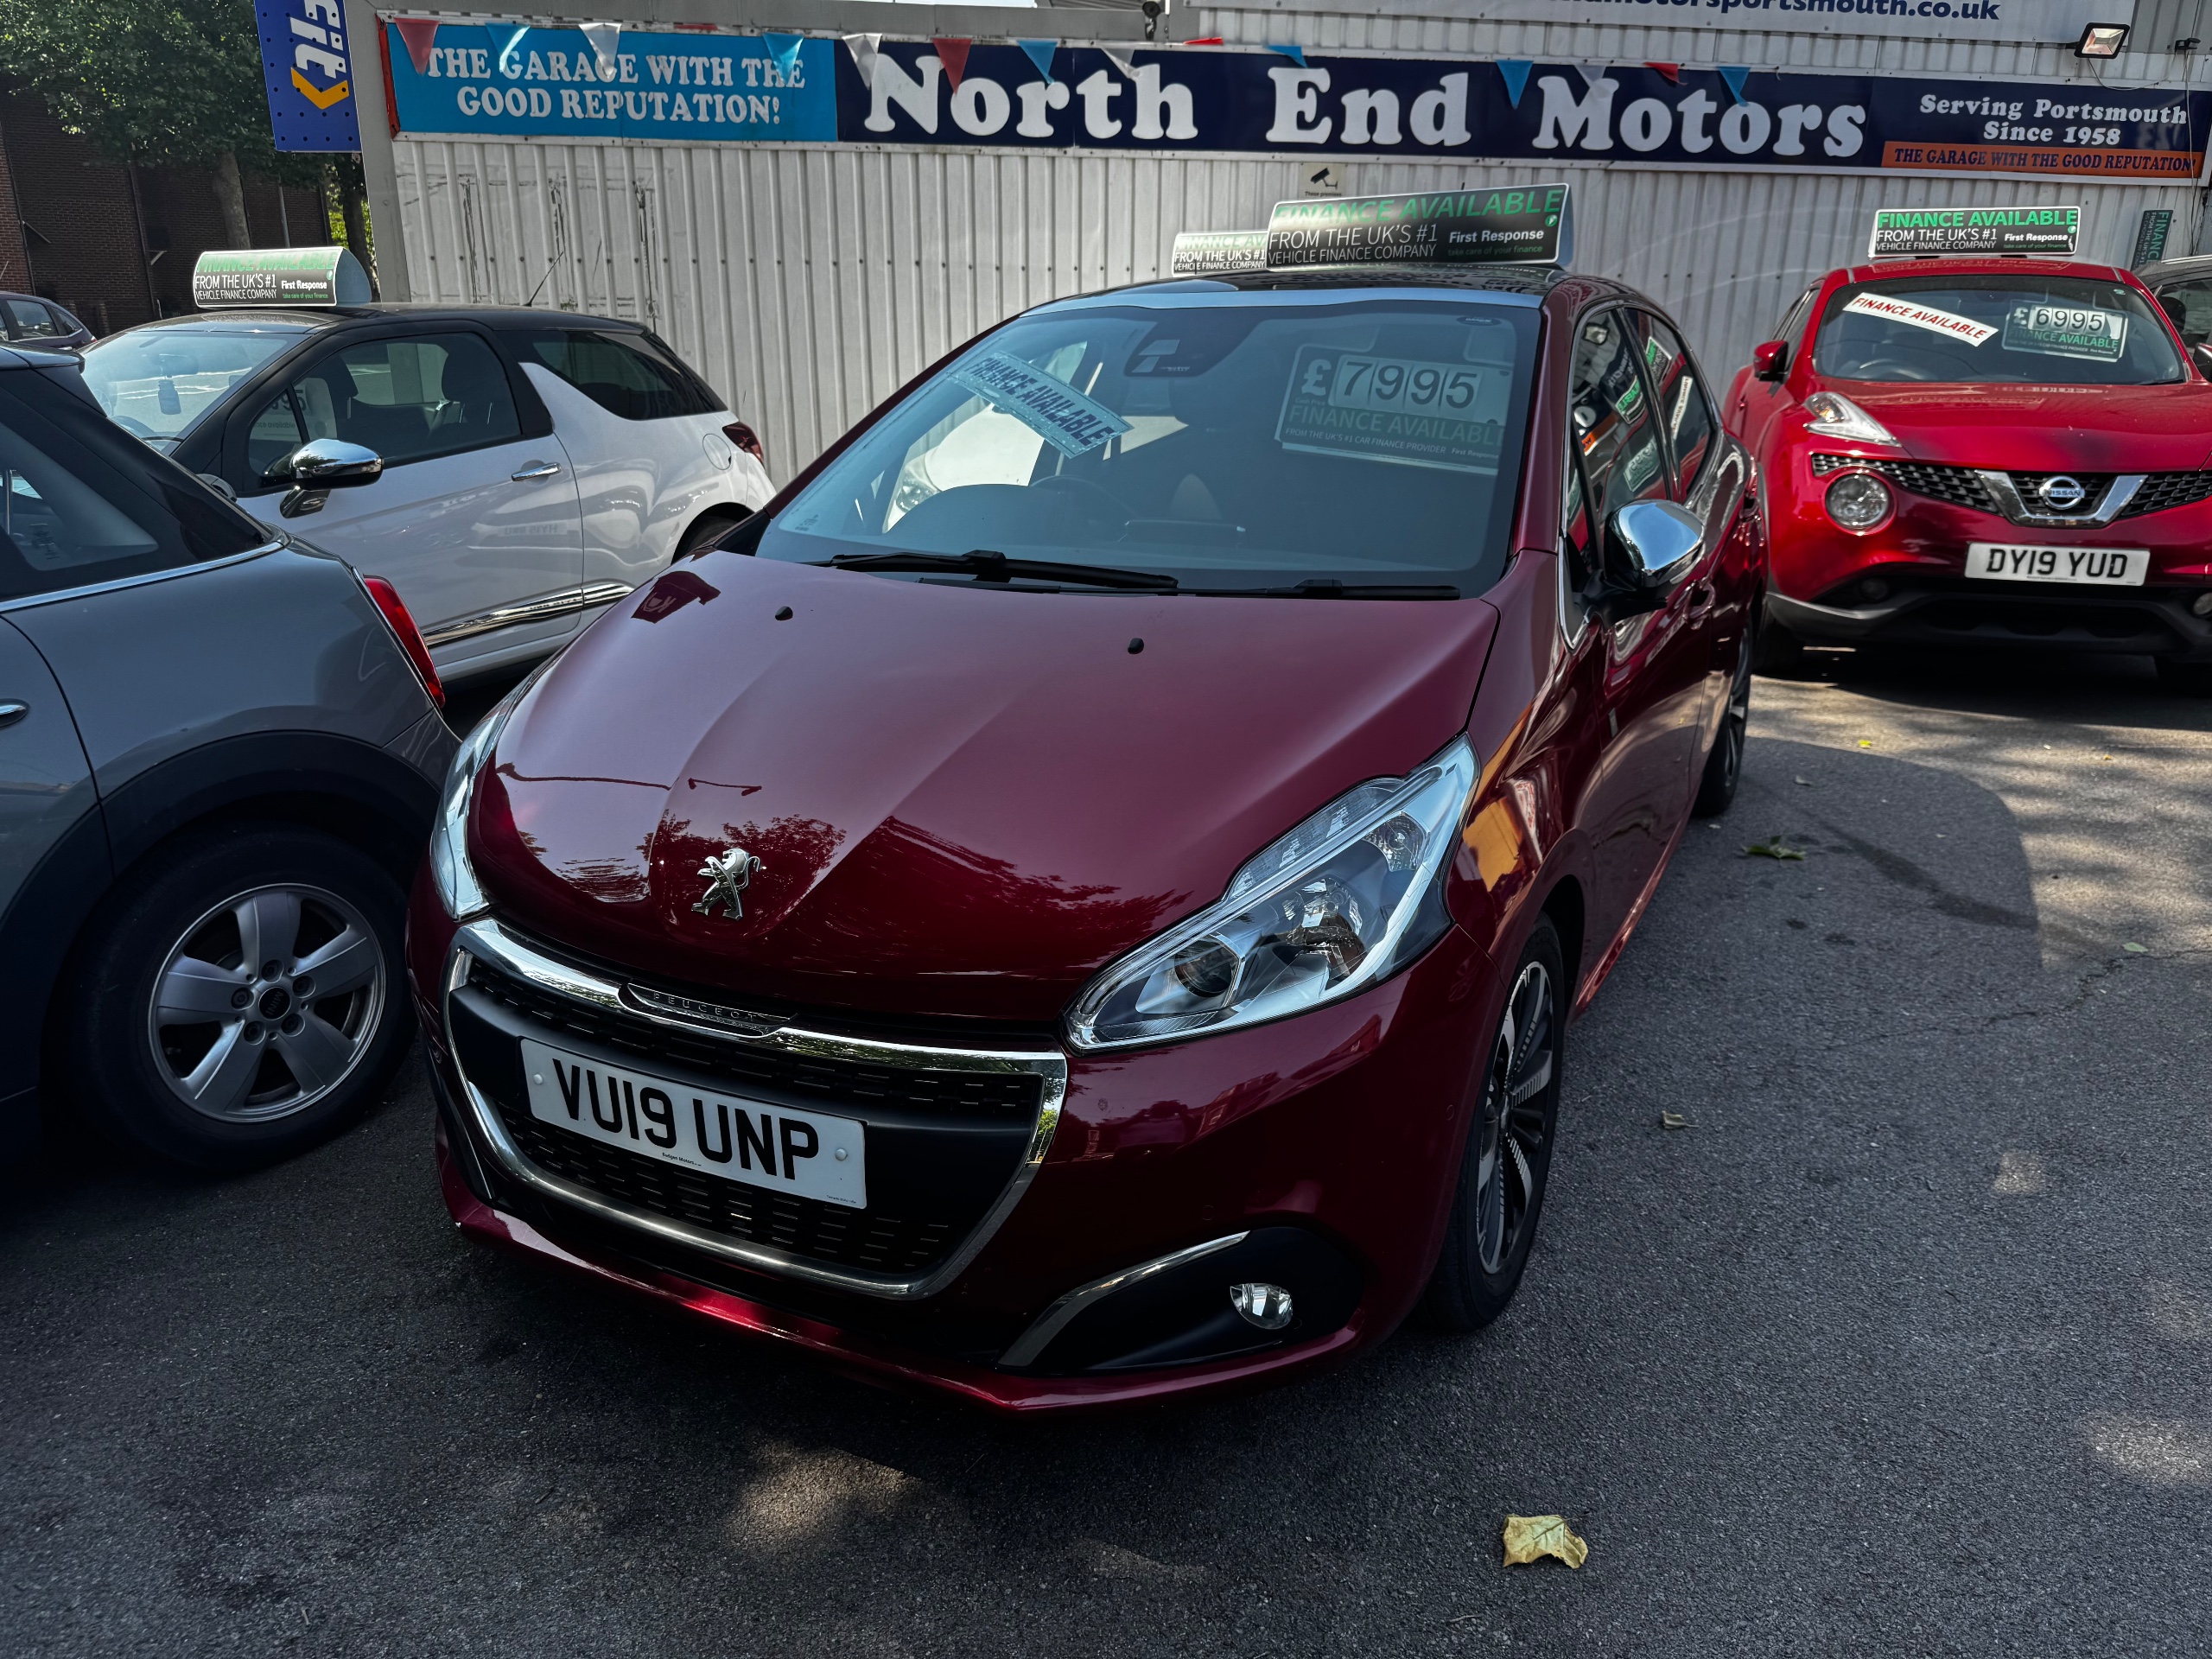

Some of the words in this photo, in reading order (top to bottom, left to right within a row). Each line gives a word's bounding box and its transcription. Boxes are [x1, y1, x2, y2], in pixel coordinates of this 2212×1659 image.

[428, 48, 491, 79] THE
[501, 50, 639, 83] GARAGE
[646, 55, 734, 86] WITH
[741, 58, 805, 88] THE
[457, 86, 551, 117] GOOD
[560, 89, 780, 124] REPUTATION!
[864, 53, 1198, 140] North
[1266, 66, 1471, 147] End
[1531, 74, 1866, 158] Motors
[1920, 94, 2024, 120] Serving
[2033, 99, 2187, 124] Portsmouth
[1984, 121, 2054, 142] Since
[2063, 127, 2121, 145] 1958
[1895, 149, 1923, 163] THE
[1927, 149, 1986, 165] GARAGE
[1991, 152, 2028, 167] WITH
[2031, 154, 2059, 168] THE
[2063, 154, 2102, 168] GOOD
[1274, 200, 1393, 224] FINANCE
[1399, 188, 1564, 221] AVAILABLE
[1878, 212, 1965, 228] FINANCE
[1968, 210, 2078, 226] AVAILABLE
[1268, 227, 1319, 250] FROM
[1325, 226, 1363, 247] THE
[1367, 225, 1411, 245] UK'S
[1416, 224, 1438, 243] #1
[1449, 232, 1478, 243] First
[1481, 230, 1544, 243] Response
[1876, 242, 1912, 251] VEHICLE
[1913, 241, 1951, 251] FINANCE
[1953, 240, 1996, 250] COMPANY
[1877, 229, 1915, 242] FROM
[1917, 229, 1943, 241] THE
[1948, 227, 1979, 240] UK'S
[1982, 228, 1998, 240] #1
[2026, 233, 2068, 242] Response
[1175, 251, 1203, 263] FROM
[1205, 251, 1225, 262] THE
[1228, 250, 1251, 261] UK'S
[1253, 249, 1266, 260] #1
[1268, 250, 1317, 264] VEHICLE
[1319, 247, 1371, 263] FINANCE
[1374, 244, 1437, 260] COMPANY
[1202, 261, 1230, 270] FINANCE
[195, 276, 219, 289] FROM
[222, 275, 240, 289] THE
[242, 273, 264, 288] UK'S
[264, 274, 276, 288] #1
[281, 280, 296, 289] First
[296, 280, 327, 290] Response
[195, 290, 220, 300] VEHICLE
[220, 289, 246, 299] FINANCE
[247, 289, 276, 299] COMPANY
[1852, 297, 1913, 316] FINANCE
[1910, 311, 1987, 339] AVAILABLE
[2008, 329, 2057, 342] FINANCE
[2058, 334, 2119, 348] AVAILABLE
[963, 357, 1038, 395] FINANCE
[1015, 385, 1116, 446] AVAILABLE
[1288, 404, 1382, 432] FINANCE
[1286, 427, 1307, 438] FROM
[1309, 429, 1324, 439] THE
[1325, 432, 1343, 442] UK'S
[1355, 435, 1370, 445] CAR
[1371, 437, 1404, 449] FINANCE
[1406, 442, 1446, 454] PROVIDER
[1451, 448, 1465, 456] First
[1467, 449, 1499, 460] Response
[1986, 549, 2056, 575] DY19
[2069, 551, 2128, 578] YUD
[652, 991, 756, 1021] PEUGEOT
[552, 1058, 677, 1149] VU19
[692, 1098, 820, 1180] UNP
